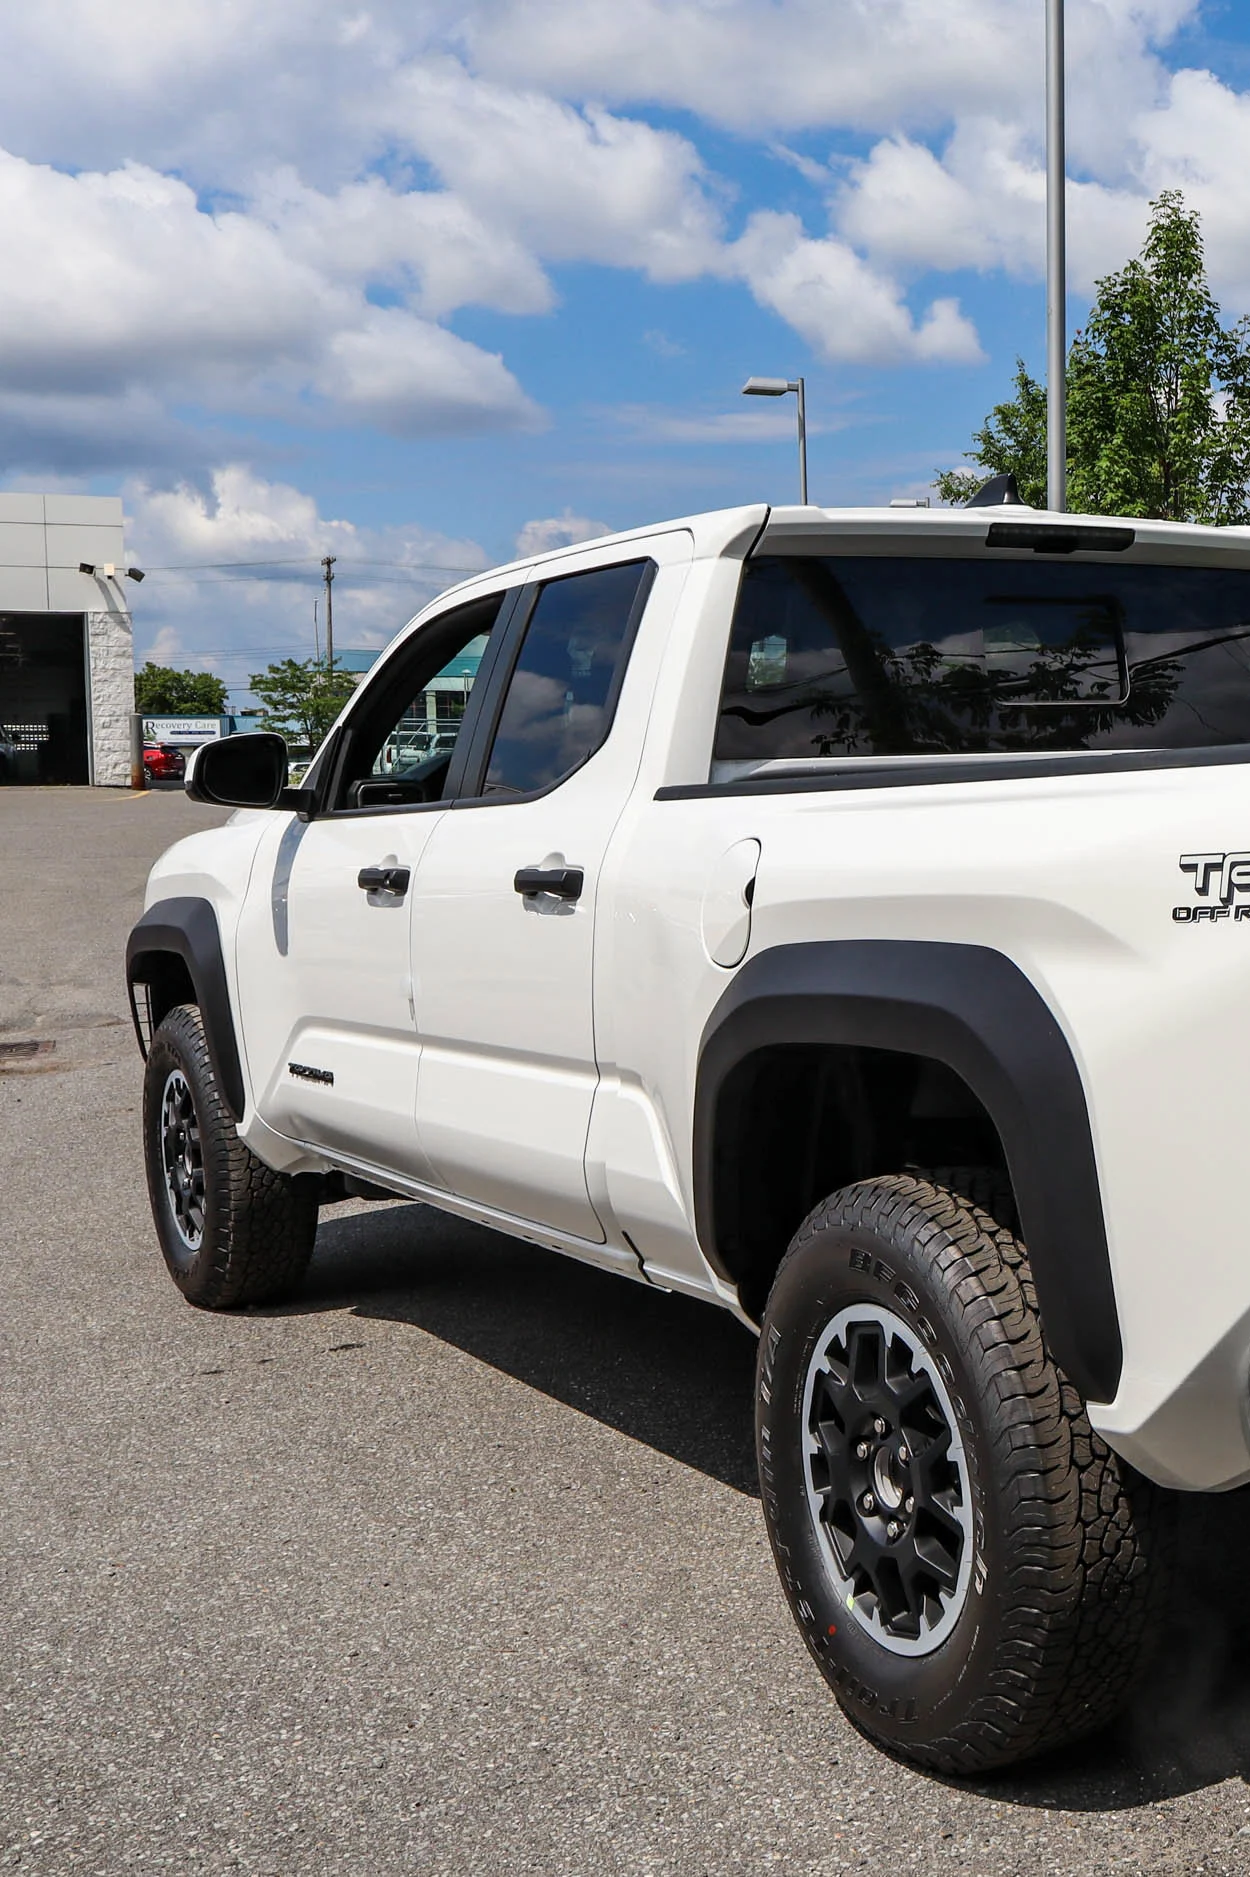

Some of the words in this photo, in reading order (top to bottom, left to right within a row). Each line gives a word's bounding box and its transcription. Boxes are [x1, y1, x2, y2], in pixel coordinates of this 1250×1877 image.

[145, 721, 193, 734] Recovery
[195, 721, 217, 729] Care
[1172, 904, 1230, 923] OFF
